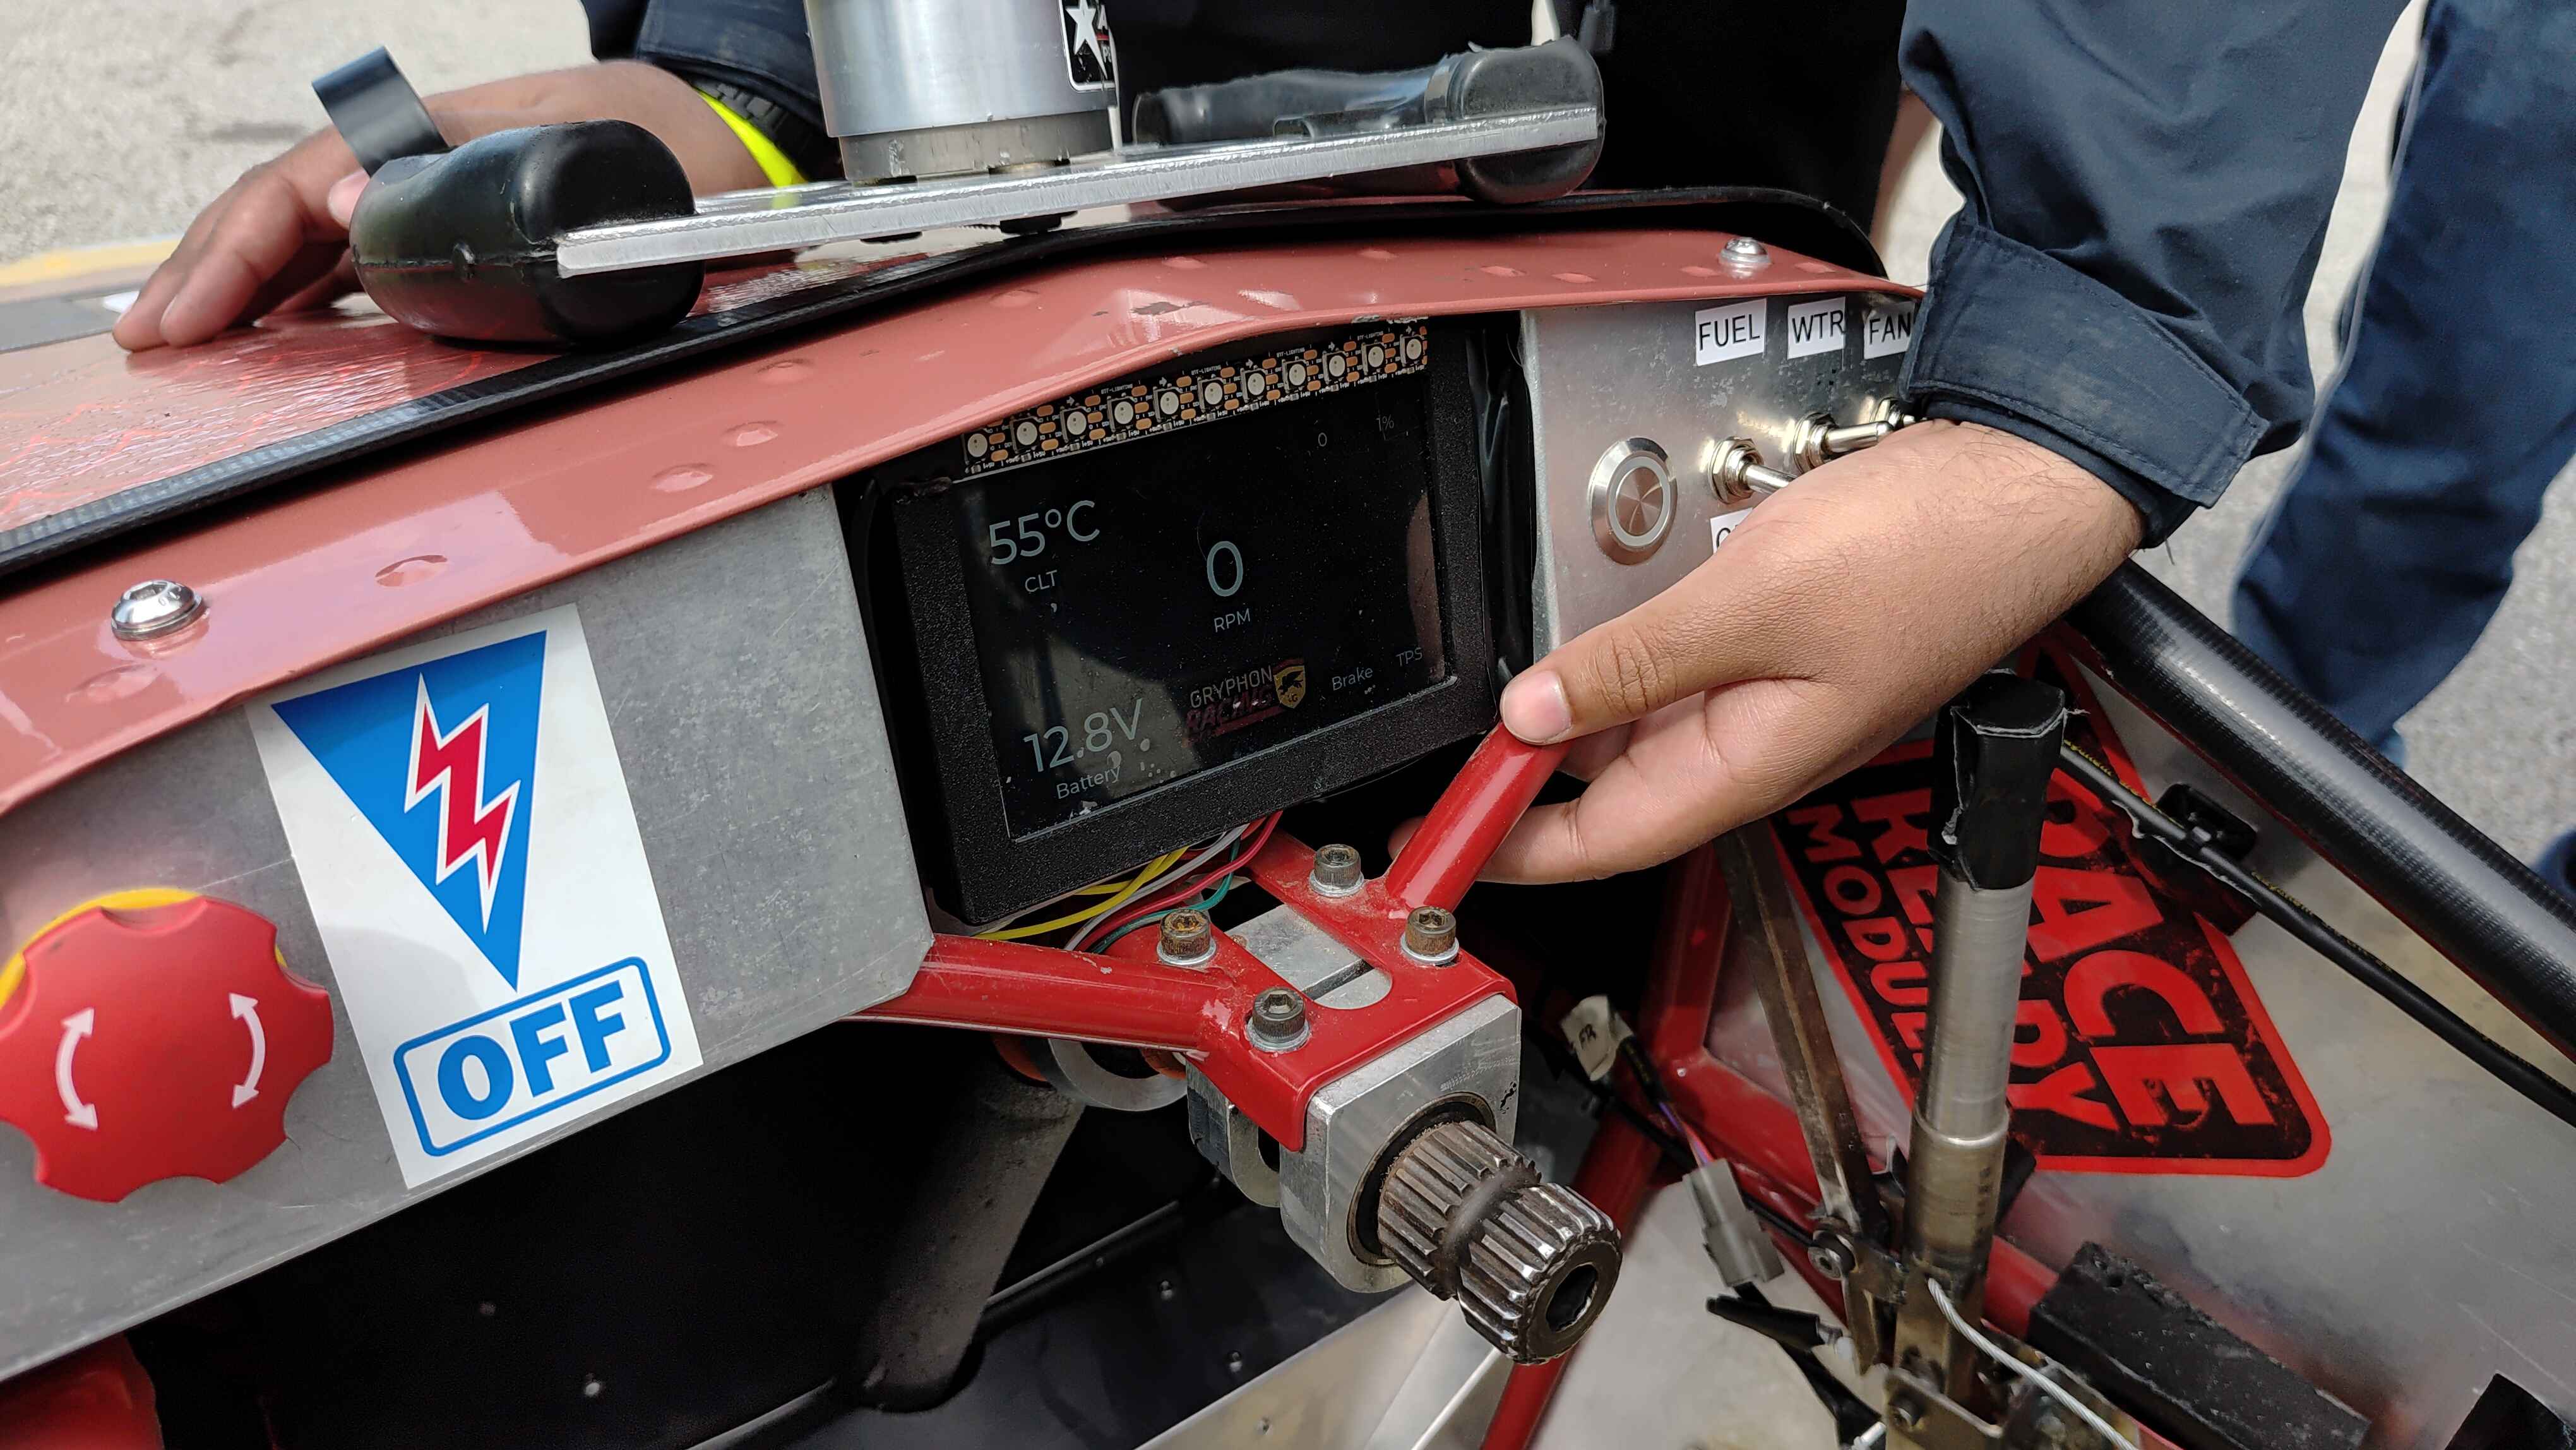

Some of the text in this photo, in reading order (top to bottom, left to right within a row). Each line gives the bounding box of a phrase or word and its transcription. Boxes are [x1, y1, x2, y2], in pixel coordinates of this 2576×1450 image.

[1698, 313, 1761, 351] FUEL
[1791, 309, 1846, 344] WTR
[1869, 312, 1912, 345] FAN
[989, 500, 1100, 565] 55°C
[1025, 570, 1058, 592] CLT
[1207, 541, 1244, 597] 0
[1213, 608, 1251, 633] RPM
[1395, 647, 1423, 668] TPS
[1190, 665, 1273, 709] GRYPHON
[1331, 666, 1373, 692] Brake
[1023, 698, 1143, 773] 12.8V
[1056, 765, 1121, 800] Battery
[1786, 803, 1929, 1072] MODU
[1849, 789, 2119, 1132] RDY
[437, 979, 626, 1121] OFF
